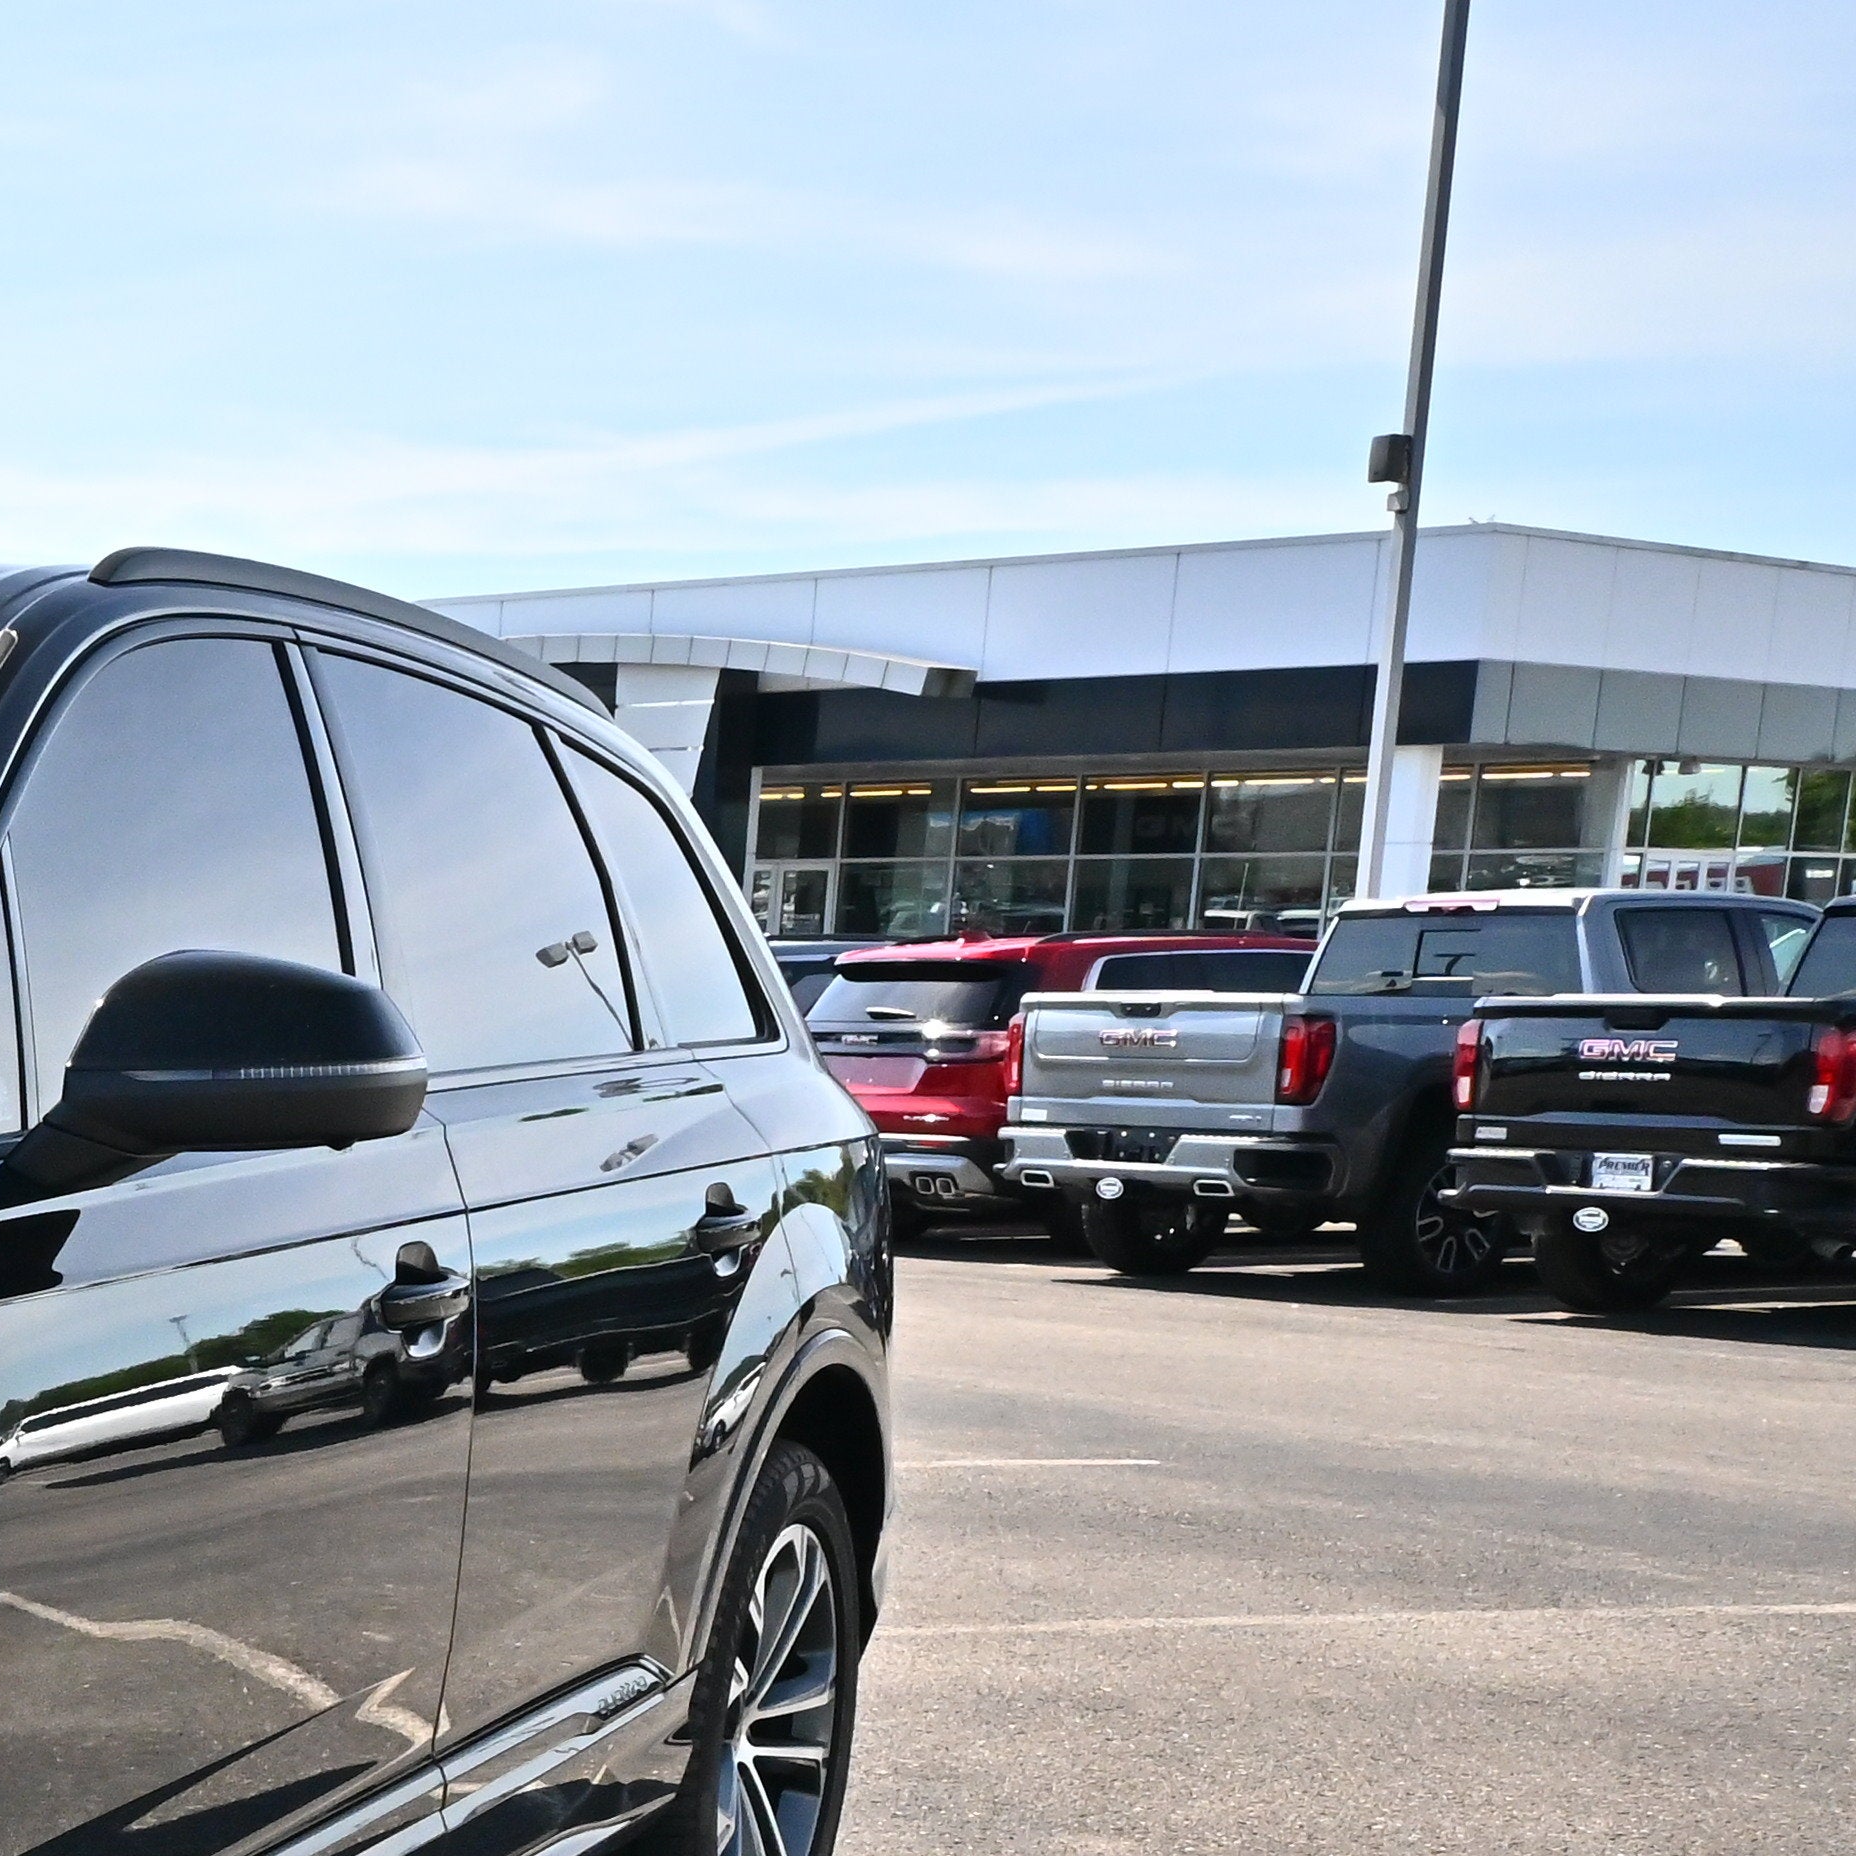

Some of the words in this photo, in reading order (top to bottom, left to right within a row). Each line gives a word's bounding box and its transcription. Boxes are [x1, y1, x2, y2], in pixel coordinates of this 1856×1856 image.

[1099, 1028, 1178, 1048] GMC
[1578, 1039, 1679, 1062] GMC
[1599, 1157, 1650, 1176] PREMIER
